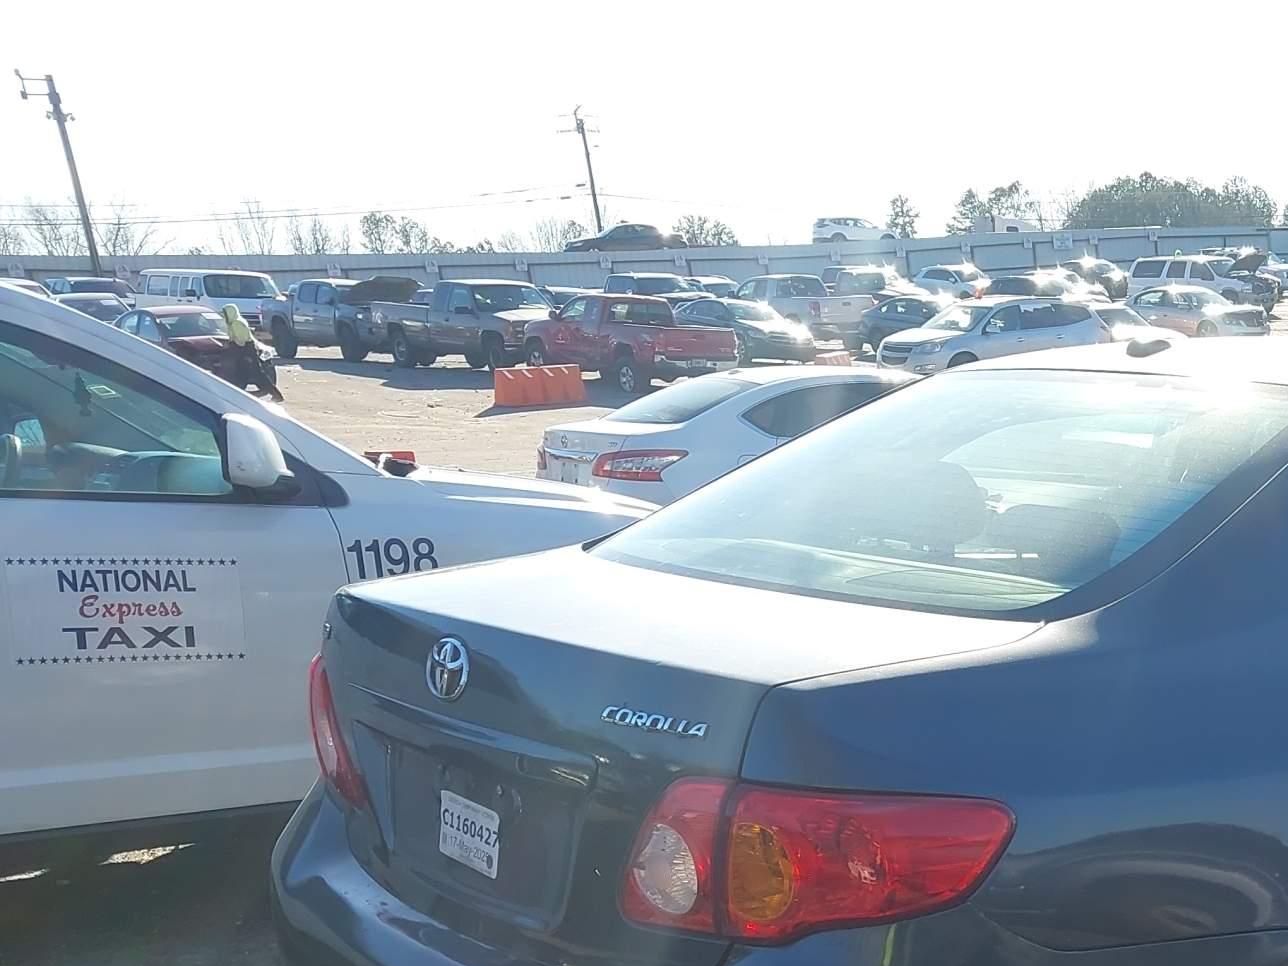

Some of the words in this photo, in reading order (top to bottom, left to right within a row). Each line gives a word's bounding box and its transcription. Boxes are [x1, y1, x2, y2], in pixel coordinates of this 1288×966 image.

[347, 537, 439, 579] 1198
[57, 569, 196, 592] NATIONAL
[79, 594, 183, 624] Express
[62, 626, 196, 650] TAXI
[600, 706, 708, 737] COROLLA
[442, 808, 499, 848] C1160427
